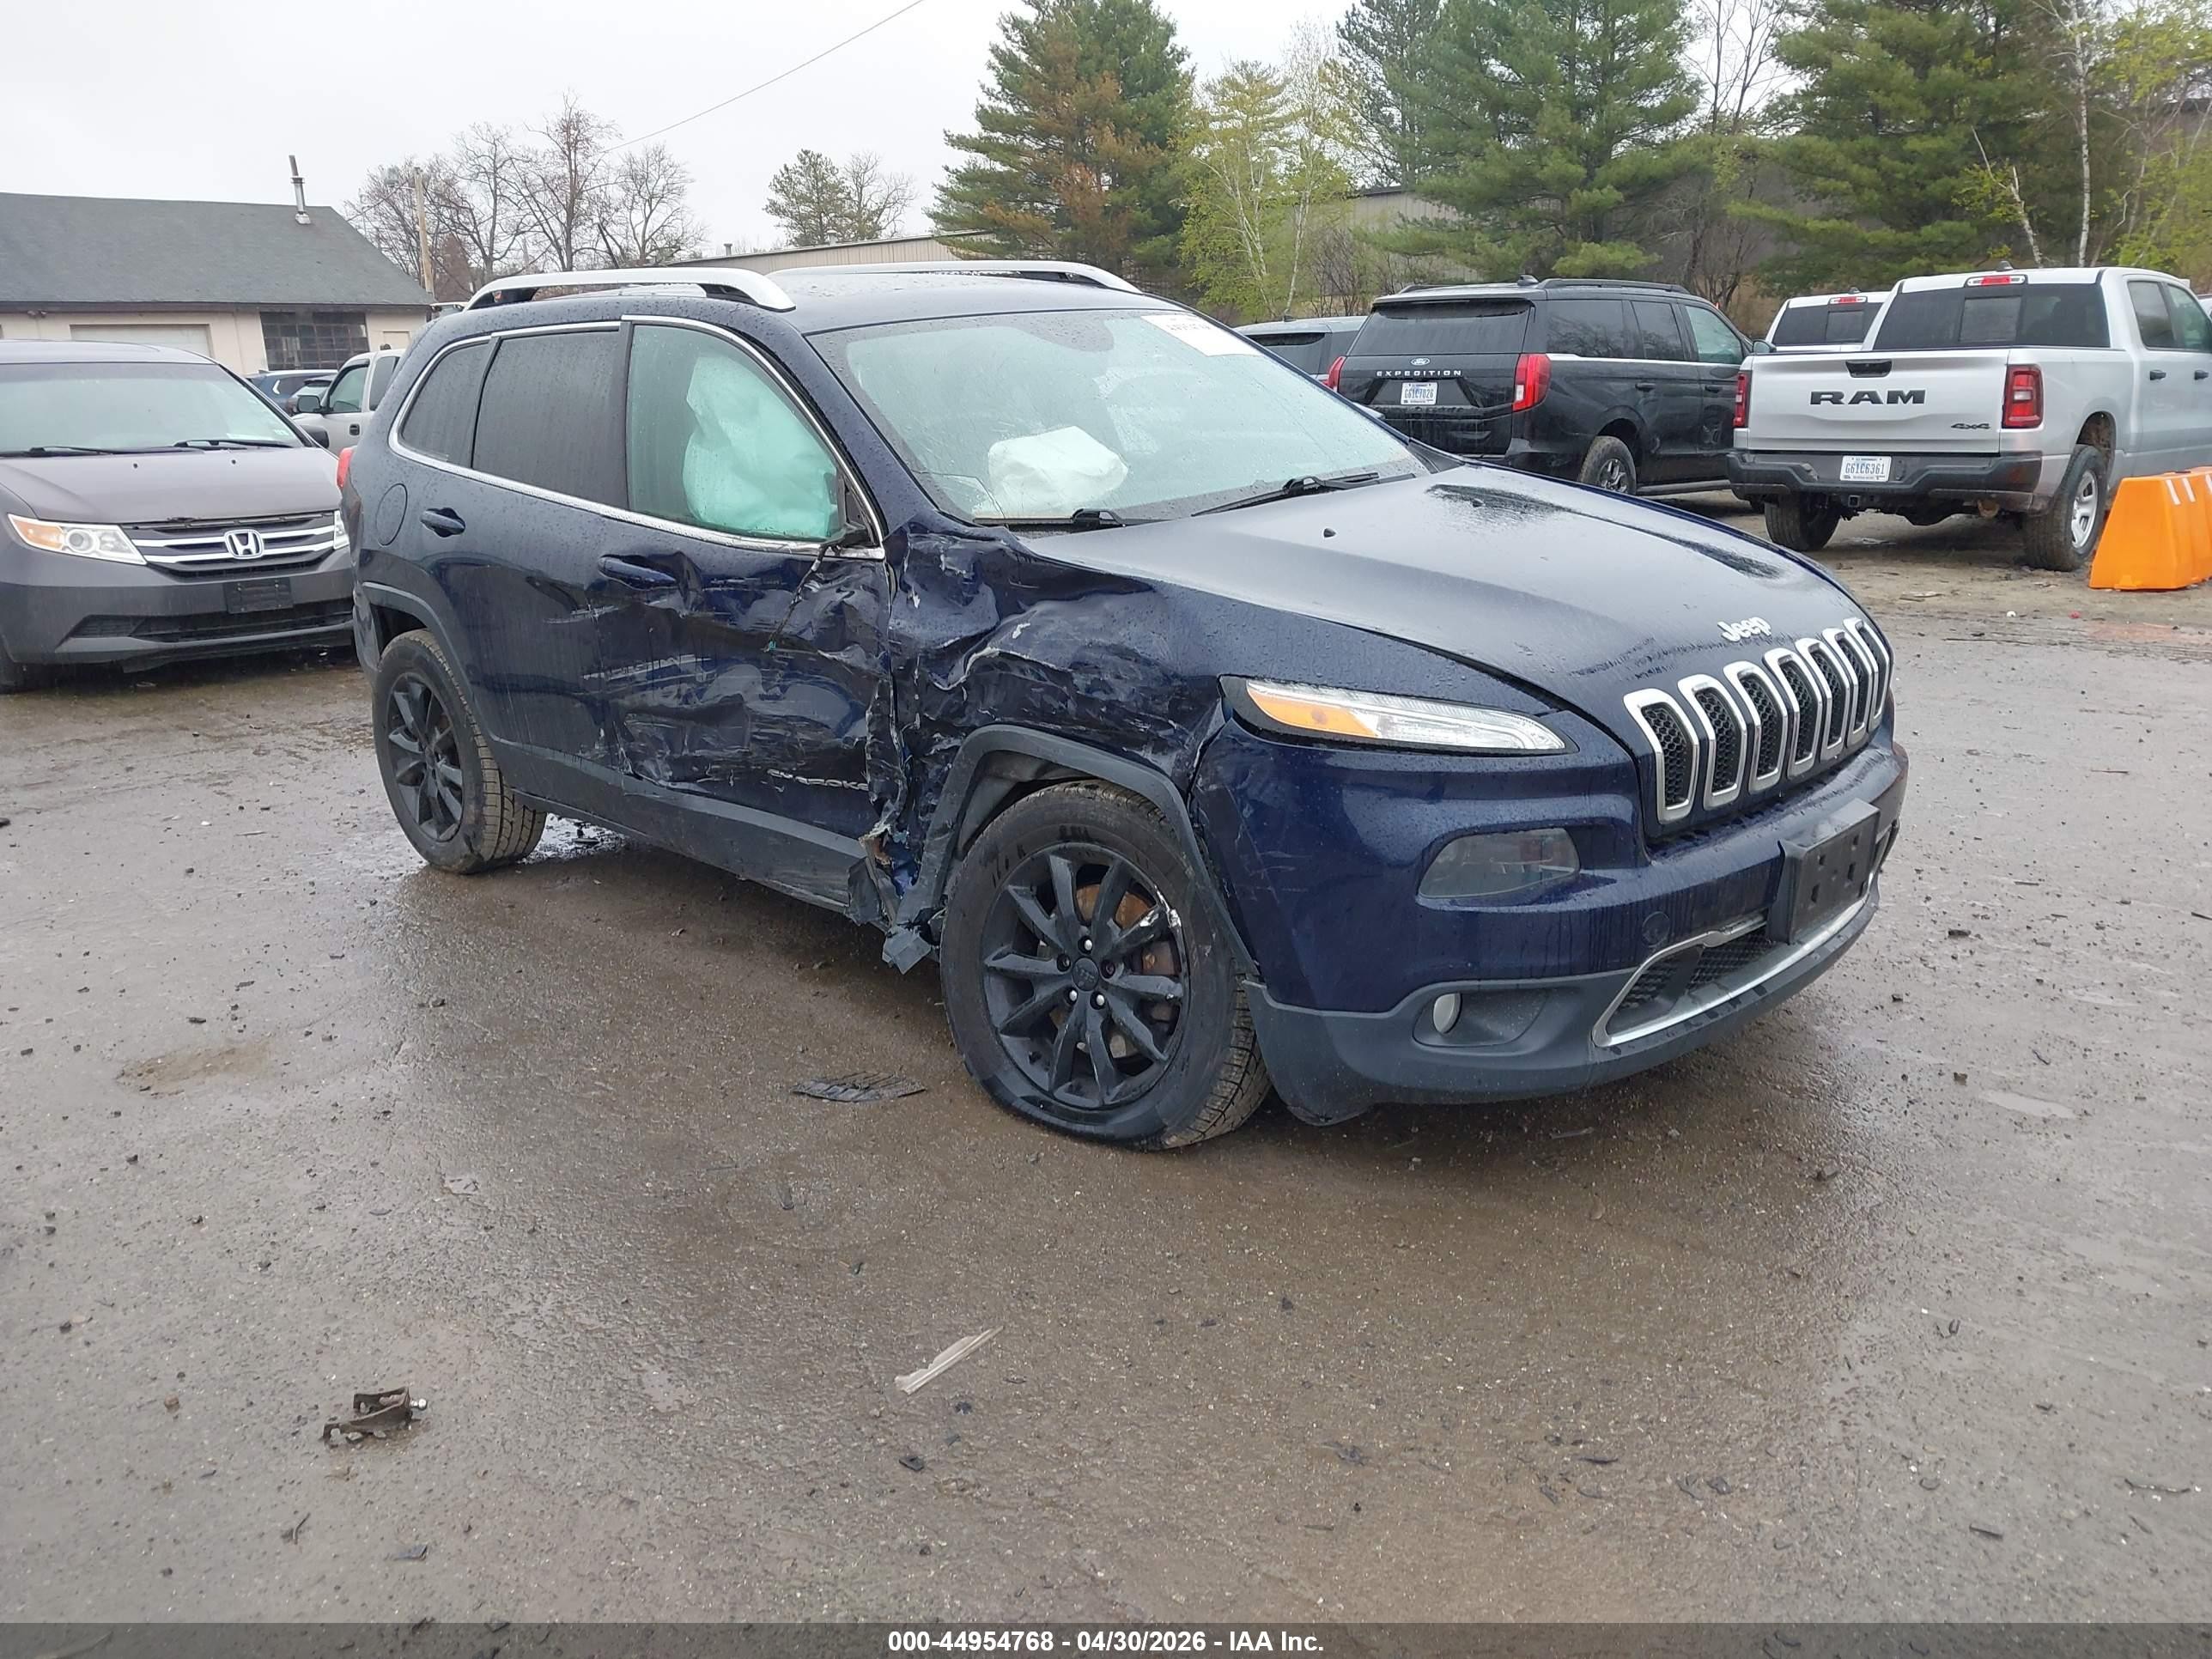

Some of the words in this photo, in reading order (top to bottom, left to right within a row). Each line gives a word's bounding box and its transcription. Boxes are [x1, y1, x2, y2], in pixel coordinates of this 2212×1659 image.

[1810, 390, 1926, 404] RAM
[1844, 462, 1885, 474] G61C6361
[1717, 617, 1771, 642] Jeep
